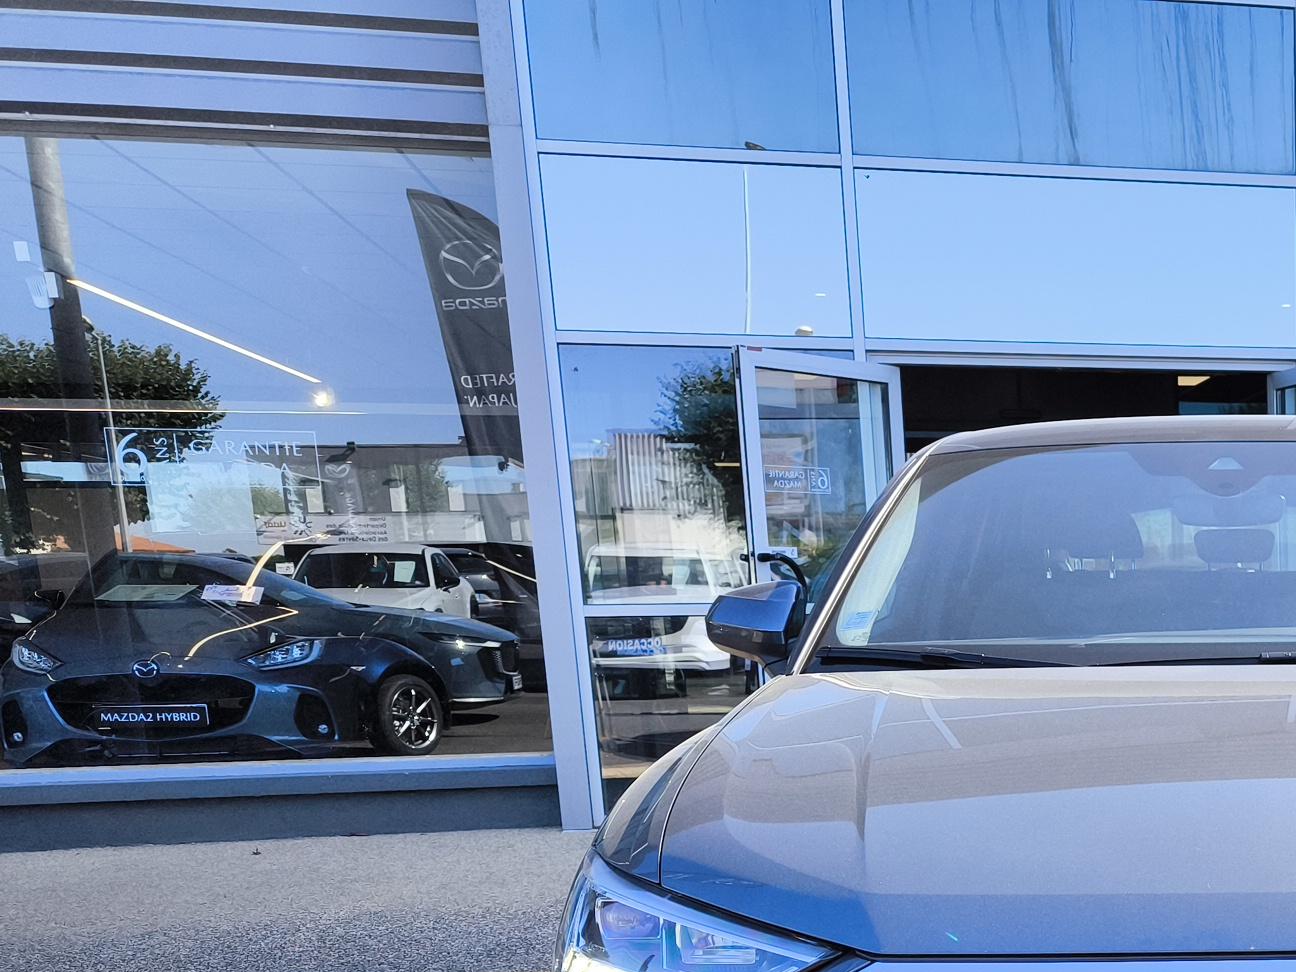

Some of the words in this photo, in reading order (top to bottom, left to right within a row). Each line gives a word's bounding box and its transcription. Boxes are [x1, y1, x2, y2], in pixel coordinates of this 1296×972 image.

[117, 432, 147, 475] 6
[153, 436, 169, 465] NS
[189, 439, 303, 457] GARANTIE
[100, 712, 154, 722] MAZDA2
[156, 712, 201, 722] HYBRID
